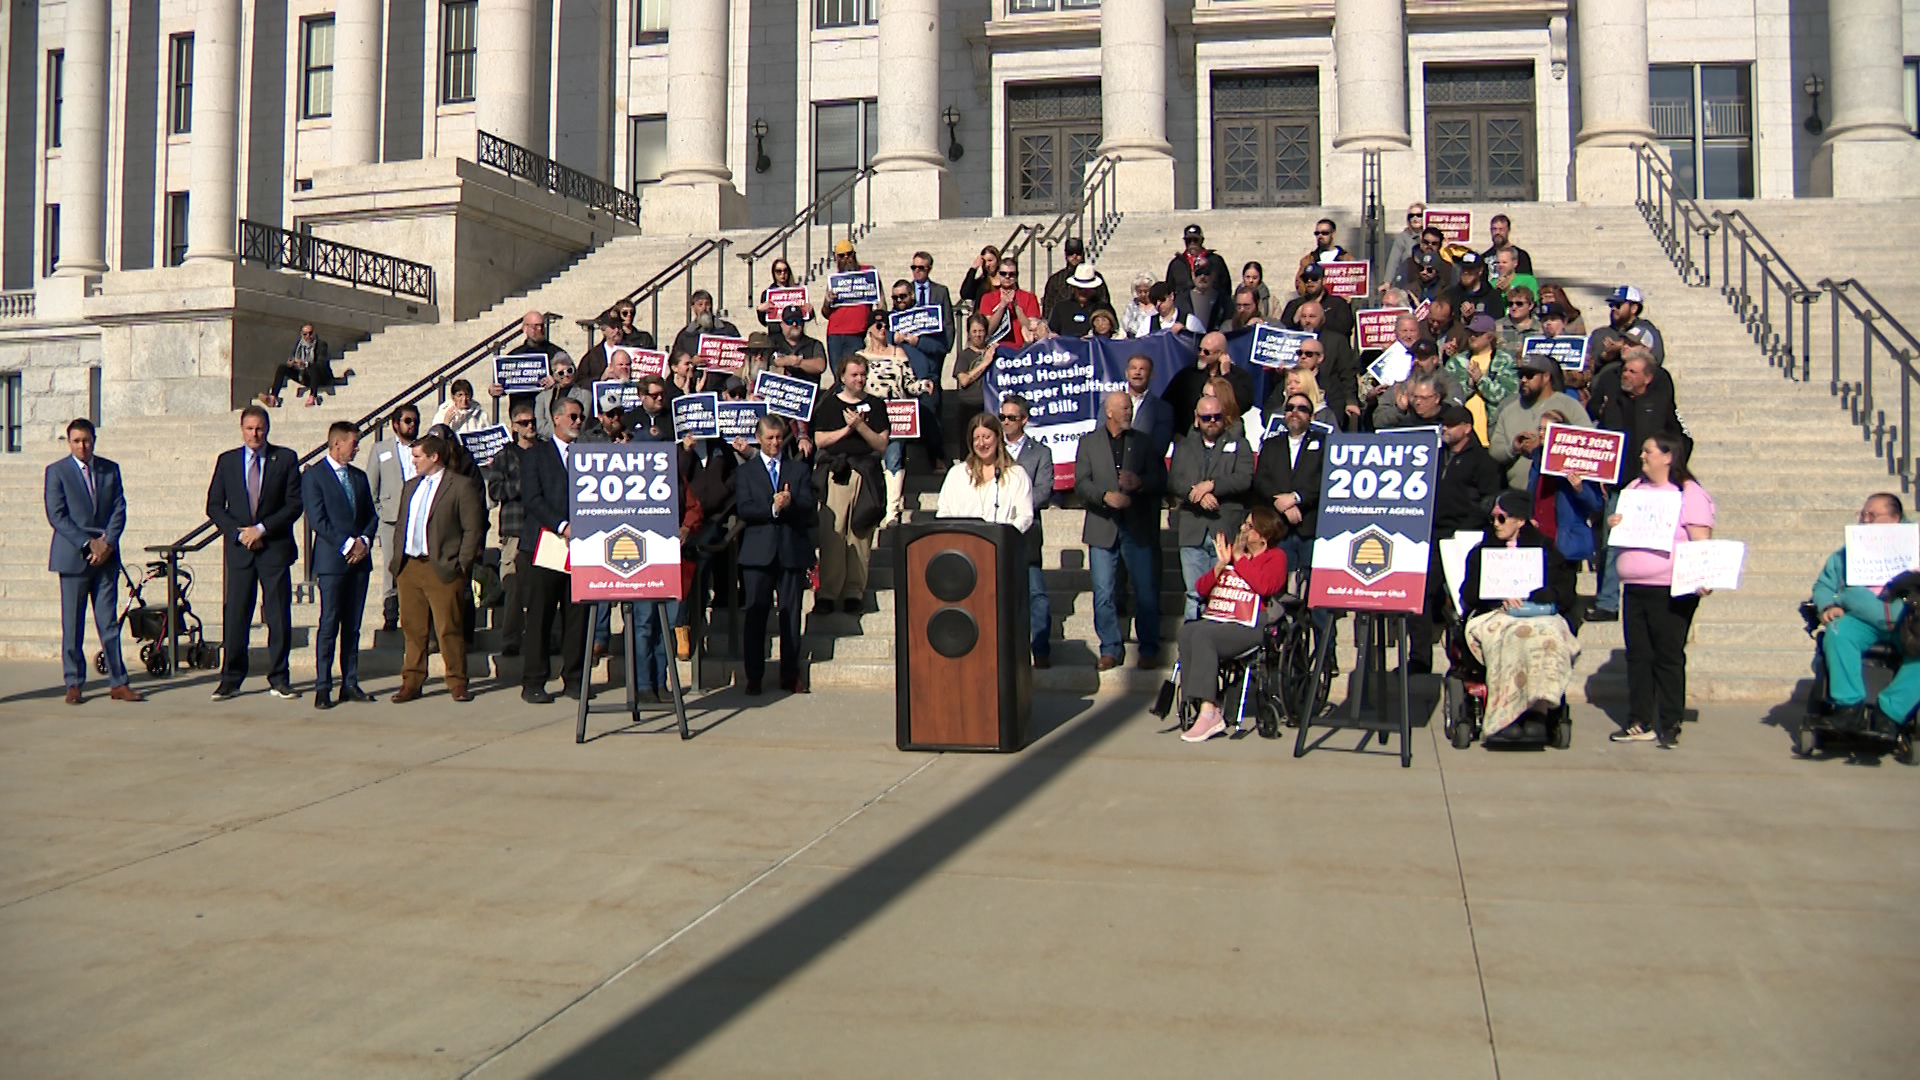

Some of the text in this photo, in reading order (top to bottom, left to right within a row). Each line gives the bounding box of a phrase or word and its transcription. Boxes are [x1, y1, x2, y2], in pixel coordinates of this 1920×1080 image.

[1441, 231, 1459, 239] GENDA
[1348, 267, 1365, 275] 2026
[995, 350, 1071, 369] Good Jobs
[997, 363, 1095, 386] More Housing
[1047, 399, 1079, 414] Bills
[1555, 433, 1615, 450] UTAH'S 2026
[1329, 444, 1430, 467] UTAH'S
[1550, 443, 1617, 462] AFFORDABILITY
[574, 452, 669, 473] UTAH'S
[1563, 457, 1599, 471] AGENDA
[576, 474, 672, 503] 2026
[1327, 468, 1429, 501] 2026
[576, 507, 672, 516] AFFORDABILITY AGENDA
[1325, 505, 1425, 516] AFFORDABILITY AGENDA
[588, 581, 606, 590] Build
[615, 581, 646, 591] Stronger
[647, 580, 665, 588] Utah
[1327, 586, 1346, 595] Build
[1354, 588, 1388, 599] Stronger
[1388, 589, 1407, 598] Utah
